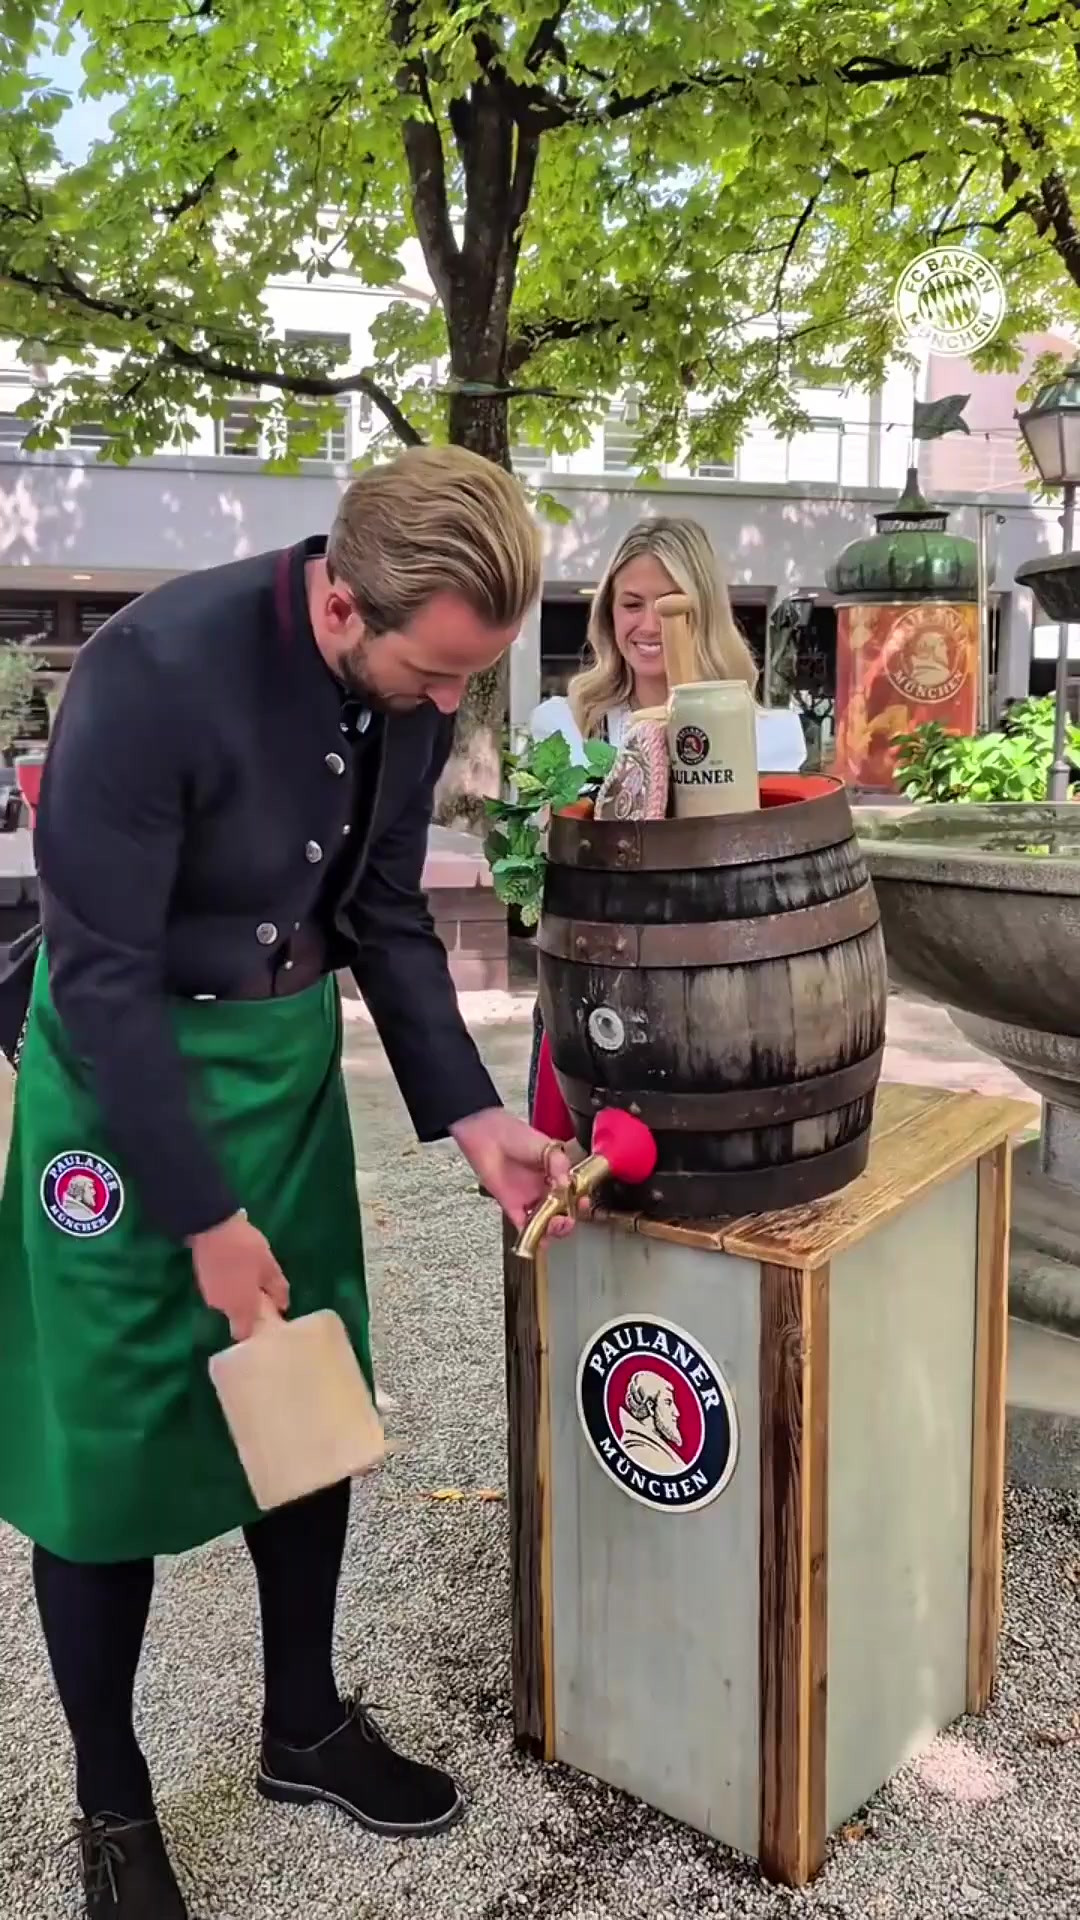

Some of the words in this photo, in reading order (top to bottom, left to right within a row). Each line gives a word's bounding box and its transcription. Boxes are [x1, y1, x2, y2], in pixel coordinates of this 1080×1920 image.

[671, 768, 735, 785] AULANER
[48, 1155, 118, 1191] PAULANER
[589, 1326, 721, 1411] PAULANER
[599, 1437, 709, 1499] MÜNCHEN
